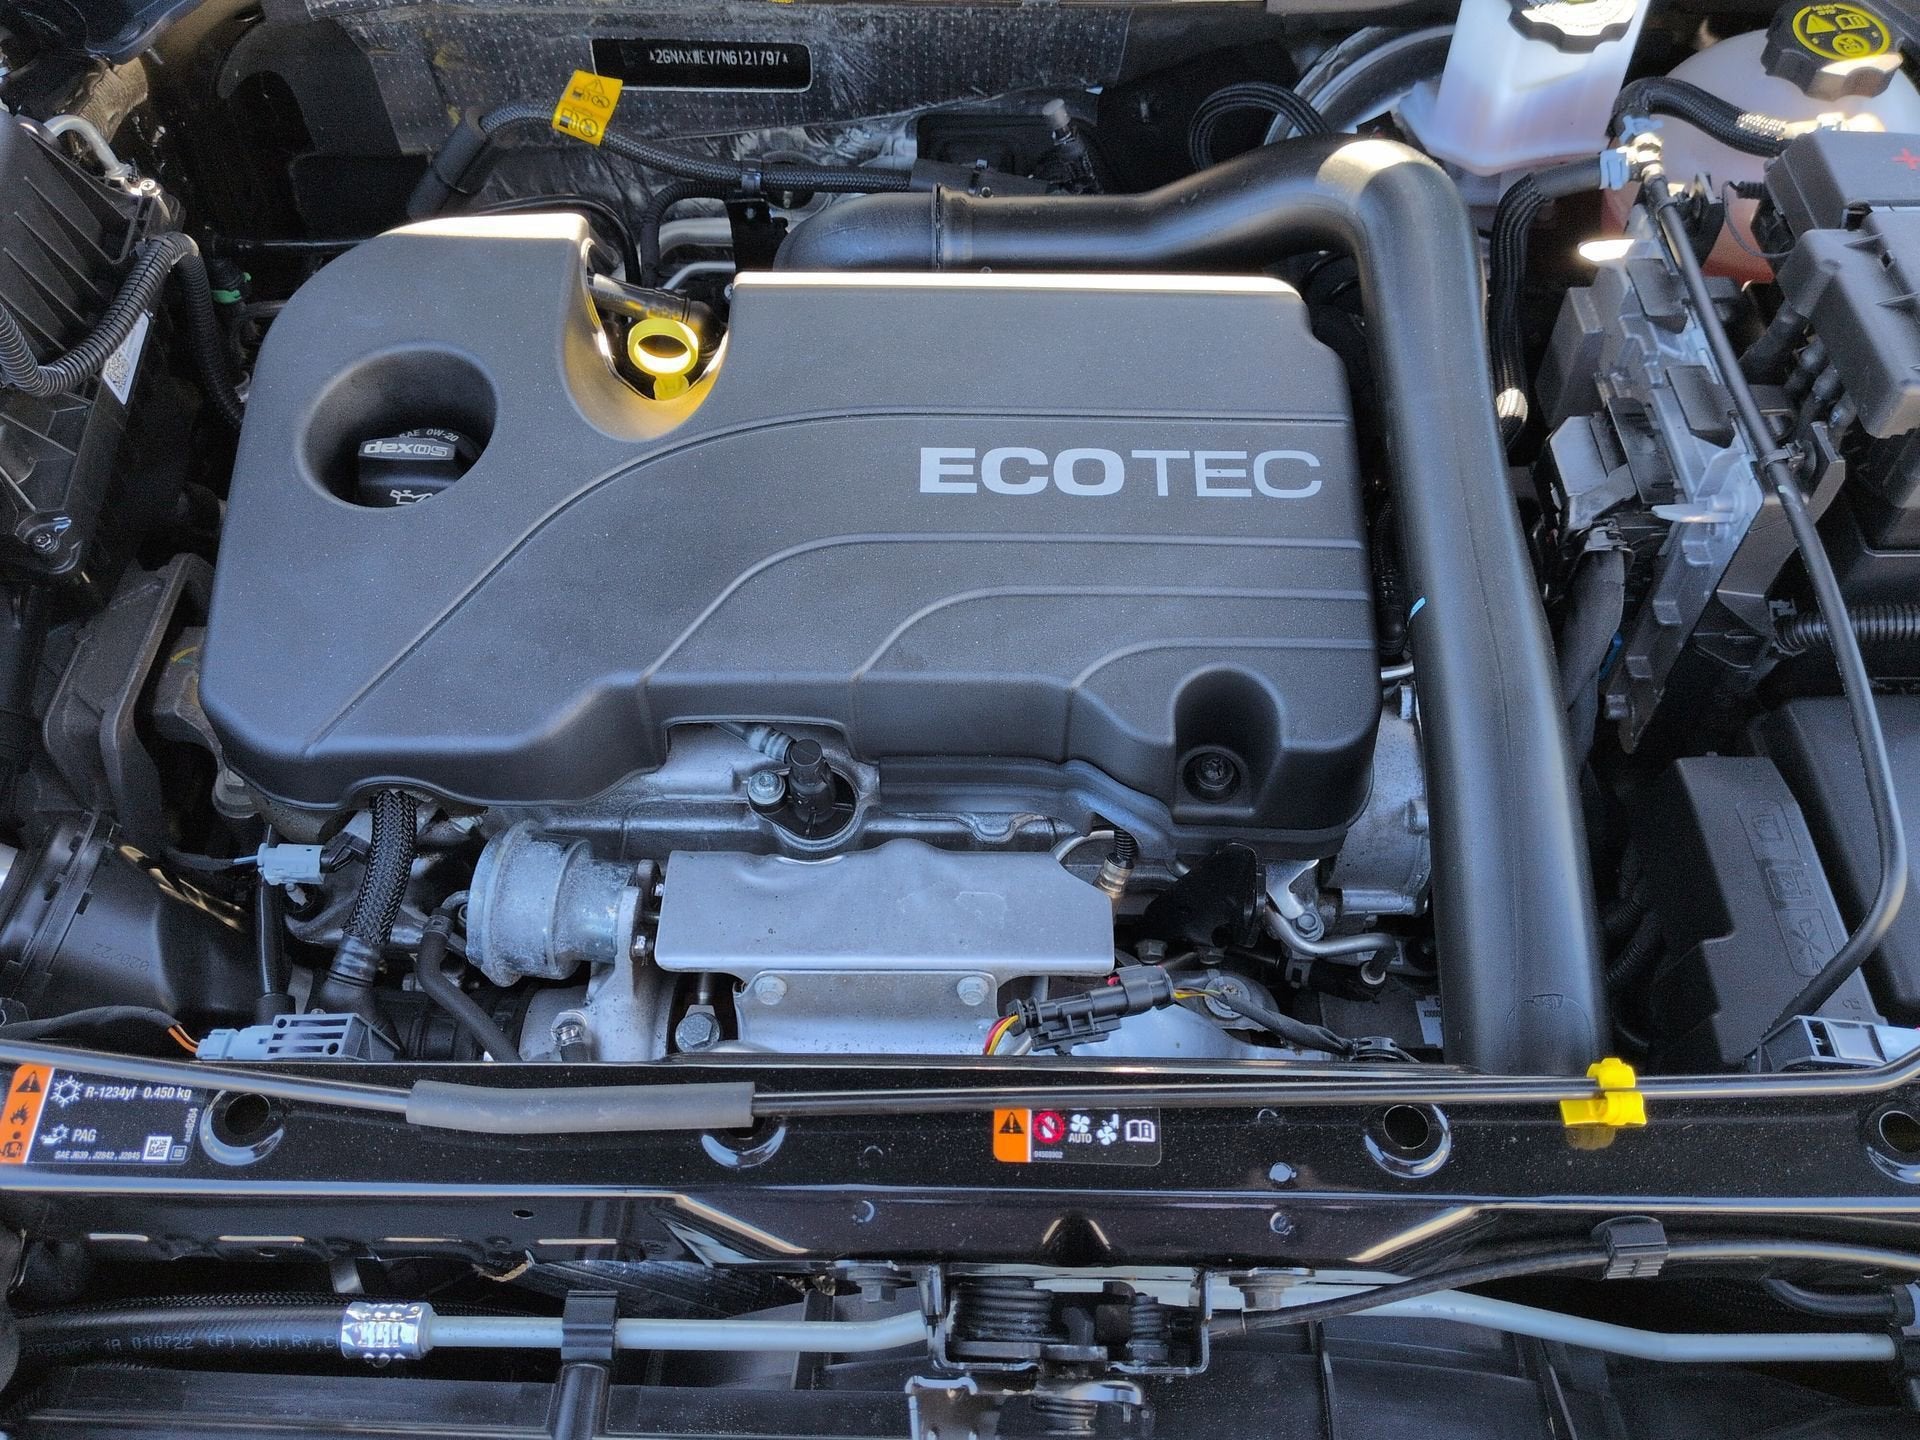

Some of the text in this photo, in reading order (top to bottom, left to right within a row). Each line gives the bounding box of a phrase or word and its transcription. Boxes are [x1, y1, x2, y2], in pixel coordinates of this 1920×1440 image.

[426, 428, 460, 442] 0W-20
[363, 440, 449, 457] dexos
[919, 446, 1323, 499] ECOTEC
[84, 1085, 192, 1101] R-1234yf 0.450 kg
[71, 1128, 97, 1143] PAG
[1067, 1132, 1093, 1144] AUTO
[54, 1150, 70, 1160] SAE
